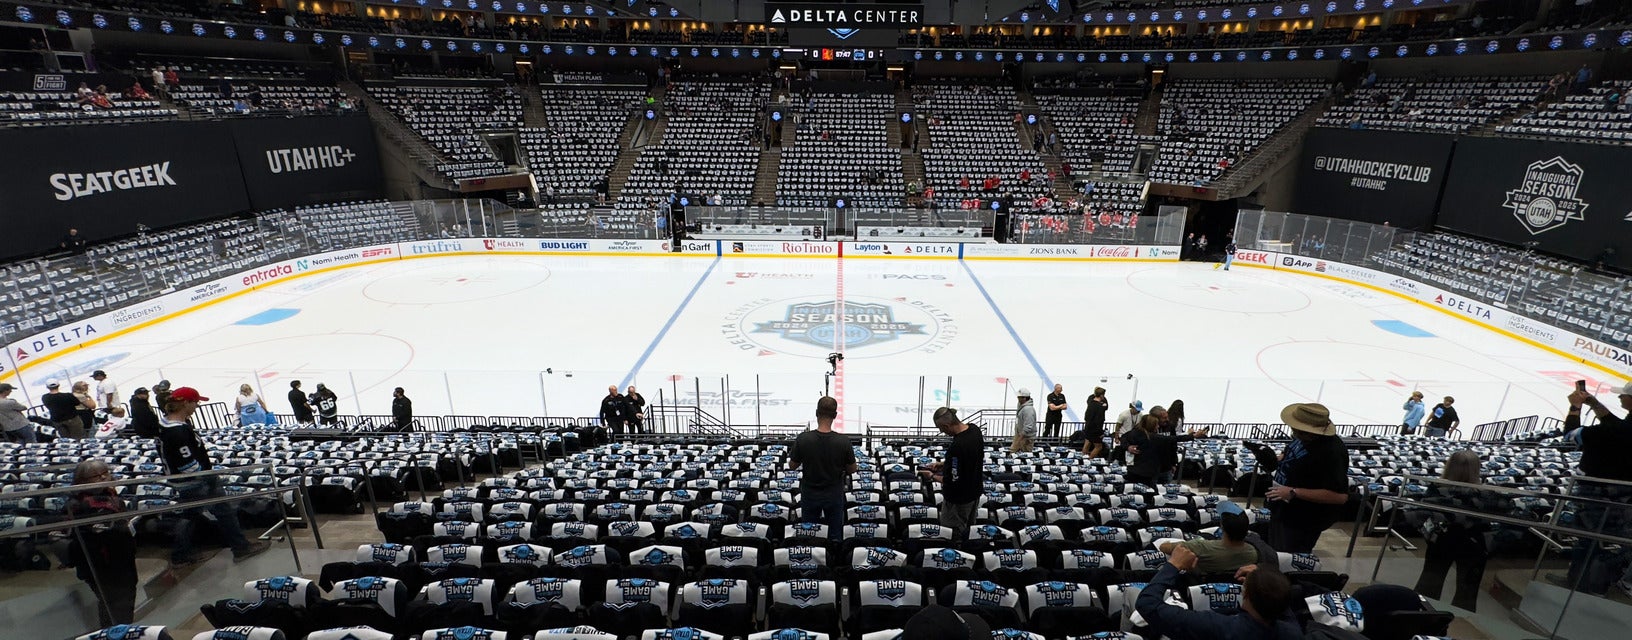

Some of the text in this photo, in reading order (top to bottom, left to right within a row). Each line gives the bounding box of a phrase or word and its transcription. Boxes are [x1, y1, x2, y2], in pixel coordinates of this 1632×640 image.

[790, 10, 918, 23] DELTA CENTER
[812, 50, 818, 58] 0
[868, 50, 874, 58] 0
[36, 76, 44, 88] 5
[266, 145, 356, 174] UTAH HC+
[1314, 156, 1432, 183] @UTAHHOCKEYCLUB
[49, 161, 177, 202] SEATGEEK
[1350, 176, 1386, 191] #UTAHHC
[1528, 170, 1576, 186] INAUGURAL
[1524, 180, 1574, 200] SEASON
[1514, 194, 1531, 202] 2024
[1558, 200, 1577, 210] 2025
[1530, 206, 1552, 219] UTAH
[362, 247, 392, 258] ESPN
[688, 243, 710, 251] Garff
[854, 244, 880, 252] Layton
[1030, 247, 1054, 255] ZIONS
[312, 258, 332, 266] Nomi
[334, 252, 359, 261] Health
[242, 263, 292, 286] entrata
[1328, 264, 1349, 274] BLACK
[1351, 270, 1376, 280] DESERT
[191, 286, 228, 302] AMERICA FIRST
[113, 304, 162, 324] INGREDIENTS
[1448, 298, 1491, 320] DELTA
[792, 314, 888, 323] SEASON
[1508, 321, 1554, 341] INGREDIENTS
[32, 324, 97, 352] DELTA
[321, 398, 335, 411] 66
[100, 422, 114, 432] 5
[180, 446, 192, 458] 9
[448, 586, 472, 595] GAME
[535, 582, 562, 592] GAME
[702, 586, 730, 595] GAME
[791, 581, 818, 590] GAME
[878, 580, 905, 590] GAME
[262, 589, 290, 600] GAME
[351, 590, 378, 599] GAME
[624, 586, 650, 596] GAME
[974, 590, 1000, 602] GAME
[1046, 590, 1073, 600] GAME
[1210, 594, 1236, 602] GAME
